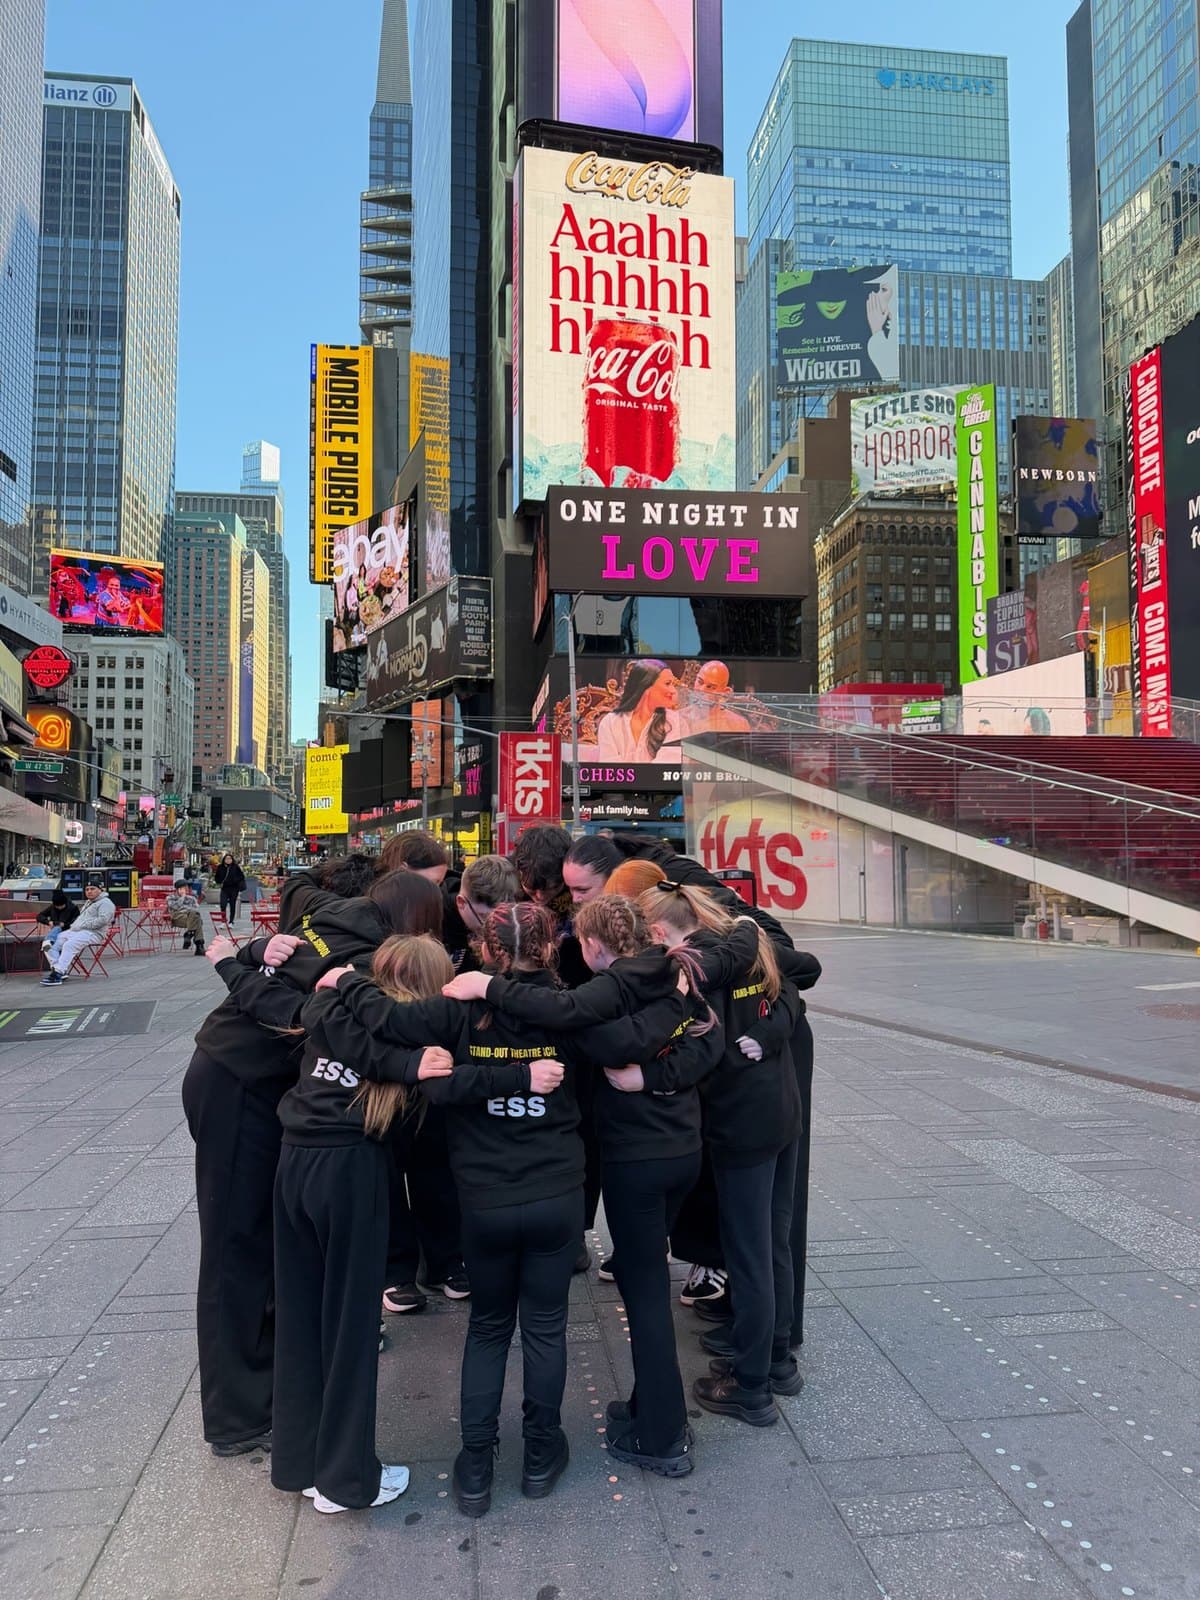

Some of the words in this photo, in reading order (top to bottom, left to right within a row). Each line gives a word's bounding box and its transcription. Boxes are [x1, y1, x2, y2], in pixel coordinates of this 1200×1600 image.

[44, 84, 88, 101] lianz
[900, 71, 993, 95] BARCLAYS
[549, 203, 710, 267] Aaahh
[549, 251, 711, 318] hhhhh
[783, 346, 818, 355] Remember
[826, 343, 863, 352] FOREVER.
[328, 357, 359, 445] MOBILE
[595, 399, 640, 409] ORIGINAL
[643, 402, 668, 413] TASTE
[960, 400, 985, 417] DAILY
[865, 395, 919, 430] LITTLE
[924, 394, 957, 415] SHO
[963, 409, 991, 427] GREEN
[1137, 363, 1161, 497] CHOCOLATE
[864, 423, 957, 481] HORROR
[328, 451, 359, 517] PUBG
[1020, 467, 1096, 482] NEWBORN
[560, 500, 626, 523] ONE
[643, 503, 748, 528] NIGHT
[763, 506, 799, 529] IN
[969, 430, 987, 638] CANNABIS
[1018, 536, 1045, 544] KEVANI
[334, 519, 409, 583] ebay
[602, 535, 760, 583] LOVE
[997, 591, 1025, 609] BROADW
[10, 605, 31, 624] HYATT
[461, 612, 489, 620] SOUTH
[994, 603, 1025, 621] "EUPHO
[464, 619, 486, 627] PARK
[460, 641, 491, 650] ROBERT
[1143, 601, 1166, 670] COME
[390, 647, 424, 678] MORMON
[463, 649, 489, 657] LOPEZ
[995, 636, 1028, 672] SI
[310, 753, 338, 763] come
[515, 738, 553, 815] tkts
[579, 768, 636, 782] CHESS
[663, 771, 691, 781] NOW
[696, 771, 711, 781] ON
[716, 771, 748, 782] BRO
[593, 806, 605, 814] all
[606, 806, 633, 817] family
[633, 806, 650, 815] here.
[700, 814, 808, 911] tkts
[510, 1047, 541, 1059] THEATRE
[311, 1057, 361, 1088] ESS
[487, 1096, 546, 1117] ESS
